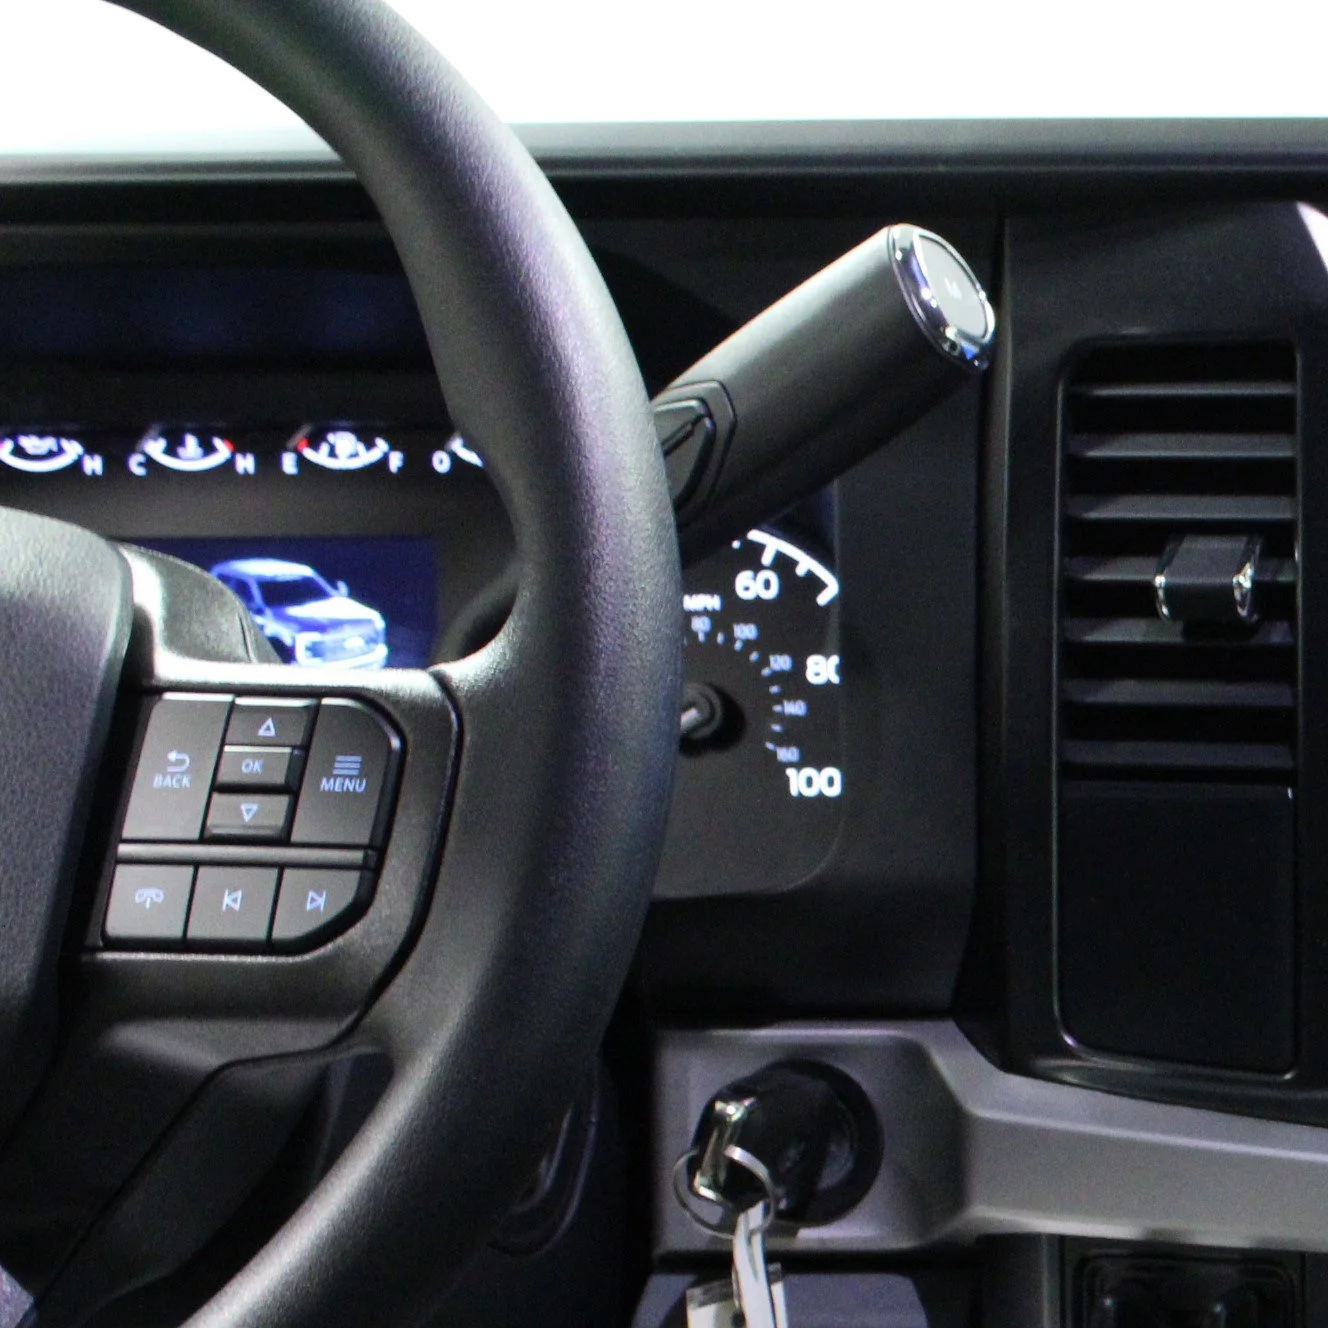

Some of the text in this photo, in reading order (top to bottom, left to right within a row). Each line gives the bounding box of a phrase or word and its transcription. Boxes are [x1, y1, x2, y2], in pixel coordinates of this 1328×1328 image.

[83, 455, 103, 475] H
[129, 455, 149, 475] C
[235, 454, 255, 474] H
[282, 452, 297, 474] E
[388, 451, 404, 473] F
[735, 570, 779, 600] 60
[241, 758, 264, 774] OK
[153, 774, 192, 789] BACK
[320, 777, 367, 792] MENU
[786, 767, 841, 797] 100
